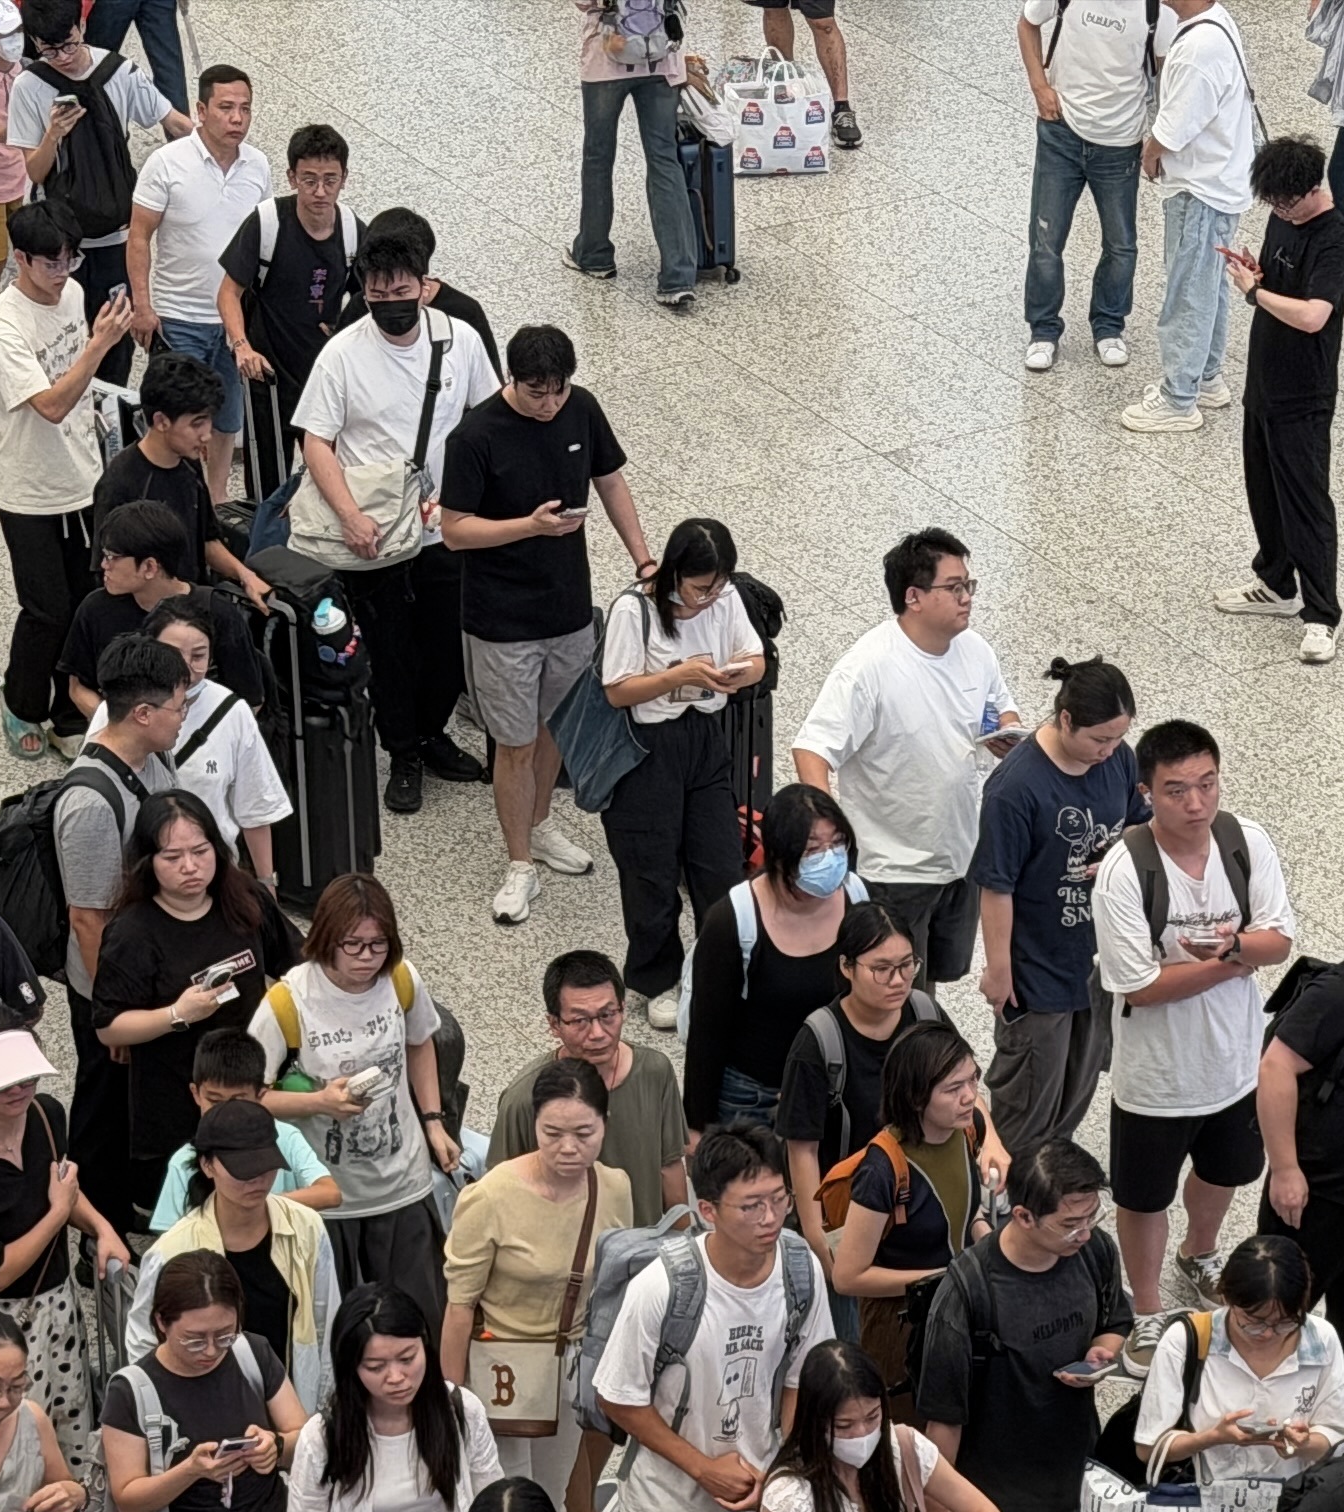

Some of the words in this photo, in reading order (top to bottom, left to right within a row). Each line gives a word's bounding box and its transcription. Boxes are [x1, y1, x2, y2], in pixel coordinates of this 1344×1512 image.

[1056, 886, 1088, 905] It's
[1060, 905, 1092, 928] SN
[729, 1325, 763, 1341] HERE'S
[490, 1364, 516, 1407] B
